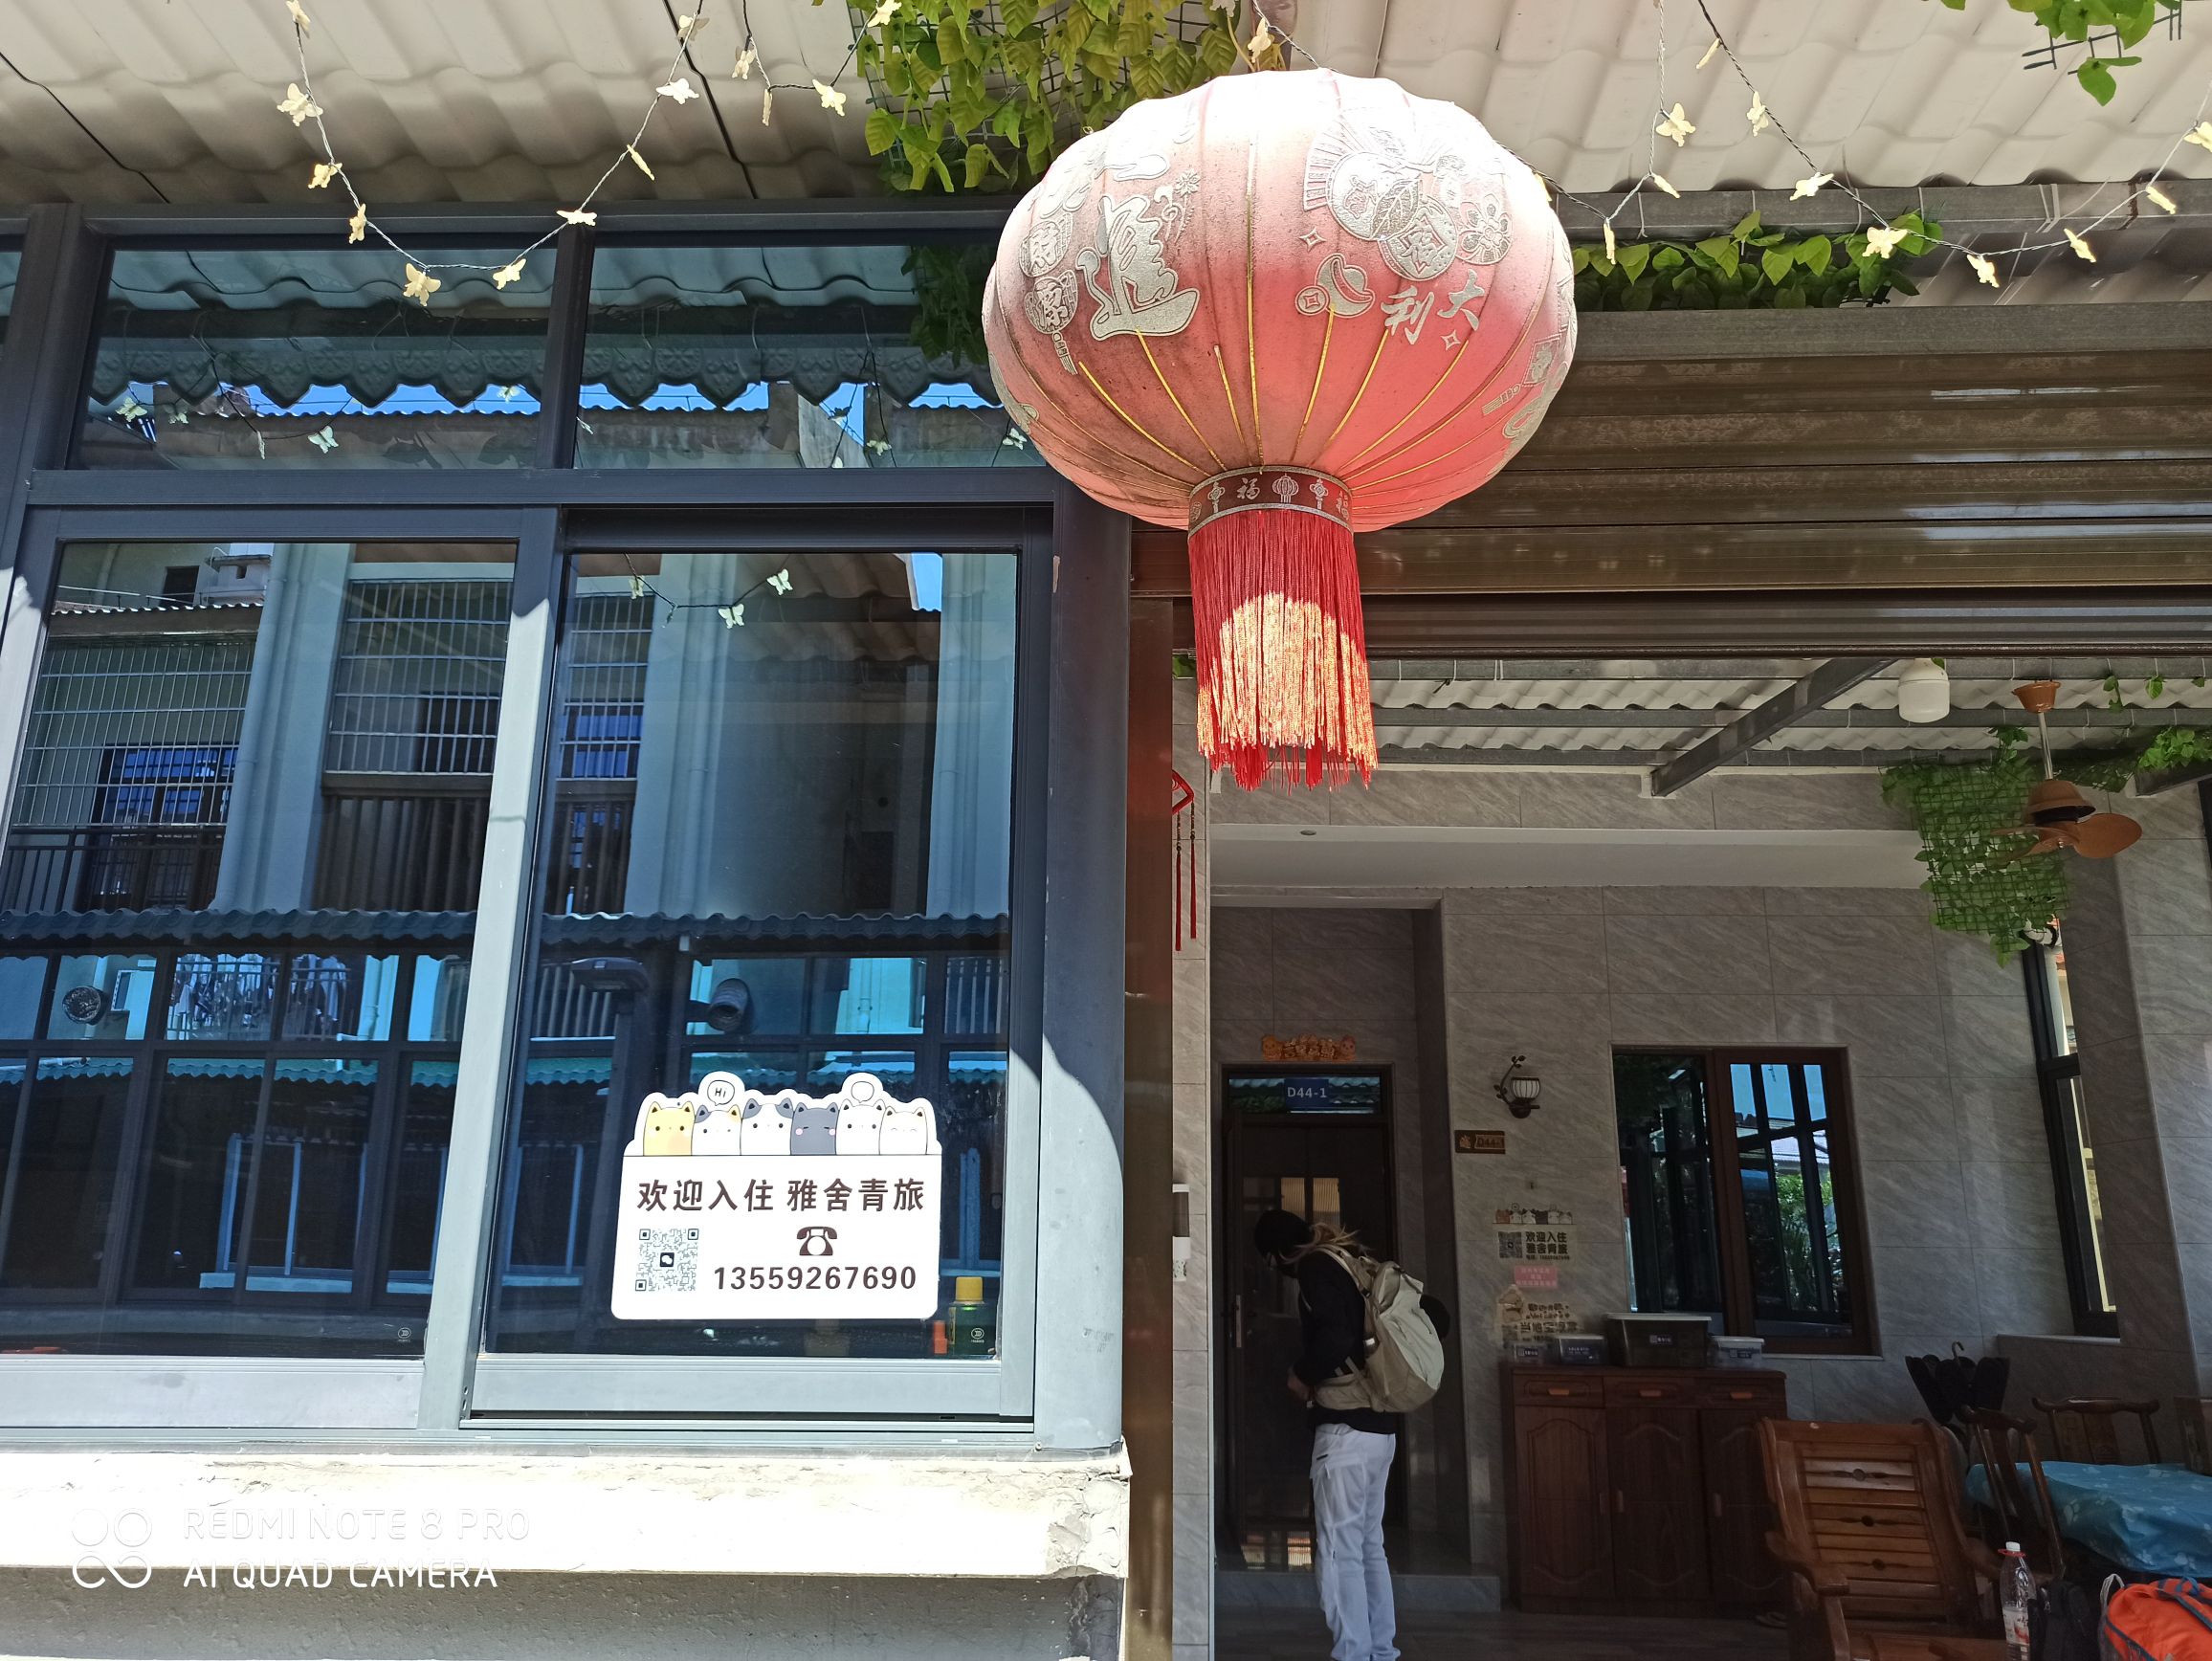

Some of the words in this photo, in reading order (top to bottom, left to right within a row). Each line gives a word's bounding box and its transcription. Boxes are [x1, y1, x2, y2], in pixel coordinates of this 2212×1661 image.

[715, 1087, 727, 1098] Hi
[1287, 1087, 1328, 1098] D44-1
[636, 1178, 774, 1212] 欢迎入住
[786, 1178, 925, 1212] 雅舍青旅
[1525, 1231, 1568, 1243] 欢迎入住
[713, 1265, 918, 1290] 13559267690
